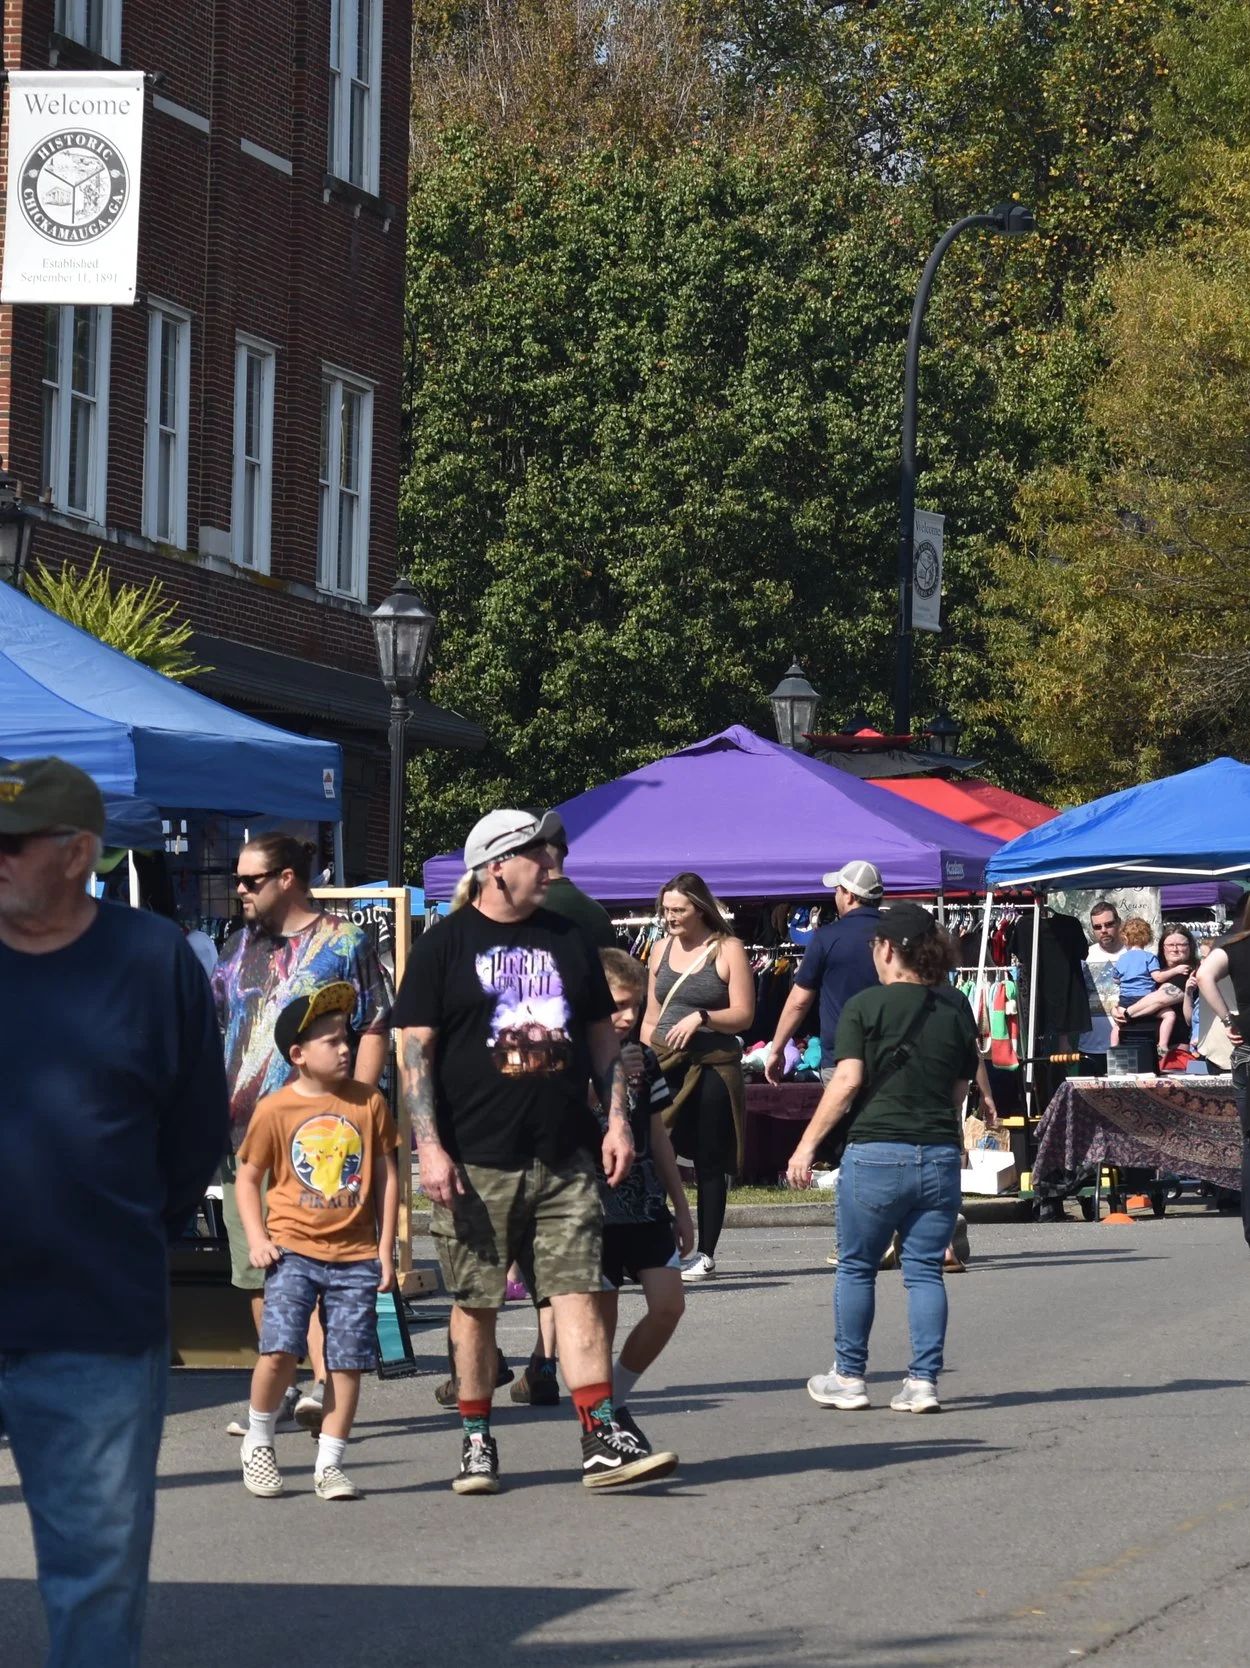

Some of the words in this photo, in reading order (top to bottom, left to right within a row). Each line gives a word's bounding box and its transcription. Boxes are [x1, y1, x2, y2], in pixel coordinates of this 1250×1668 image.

[24, 93, 131, 115] Welcome
[37, 134, 114, 161] HISTORIC
[23, 188, 114, 240] CHICKAMAUGA,
[107, 188, 125, 217] GA.
[42, 257, 99, 269] Established
[20, 272, 73, 284] September
[95, 272, 118, 283] 1891
